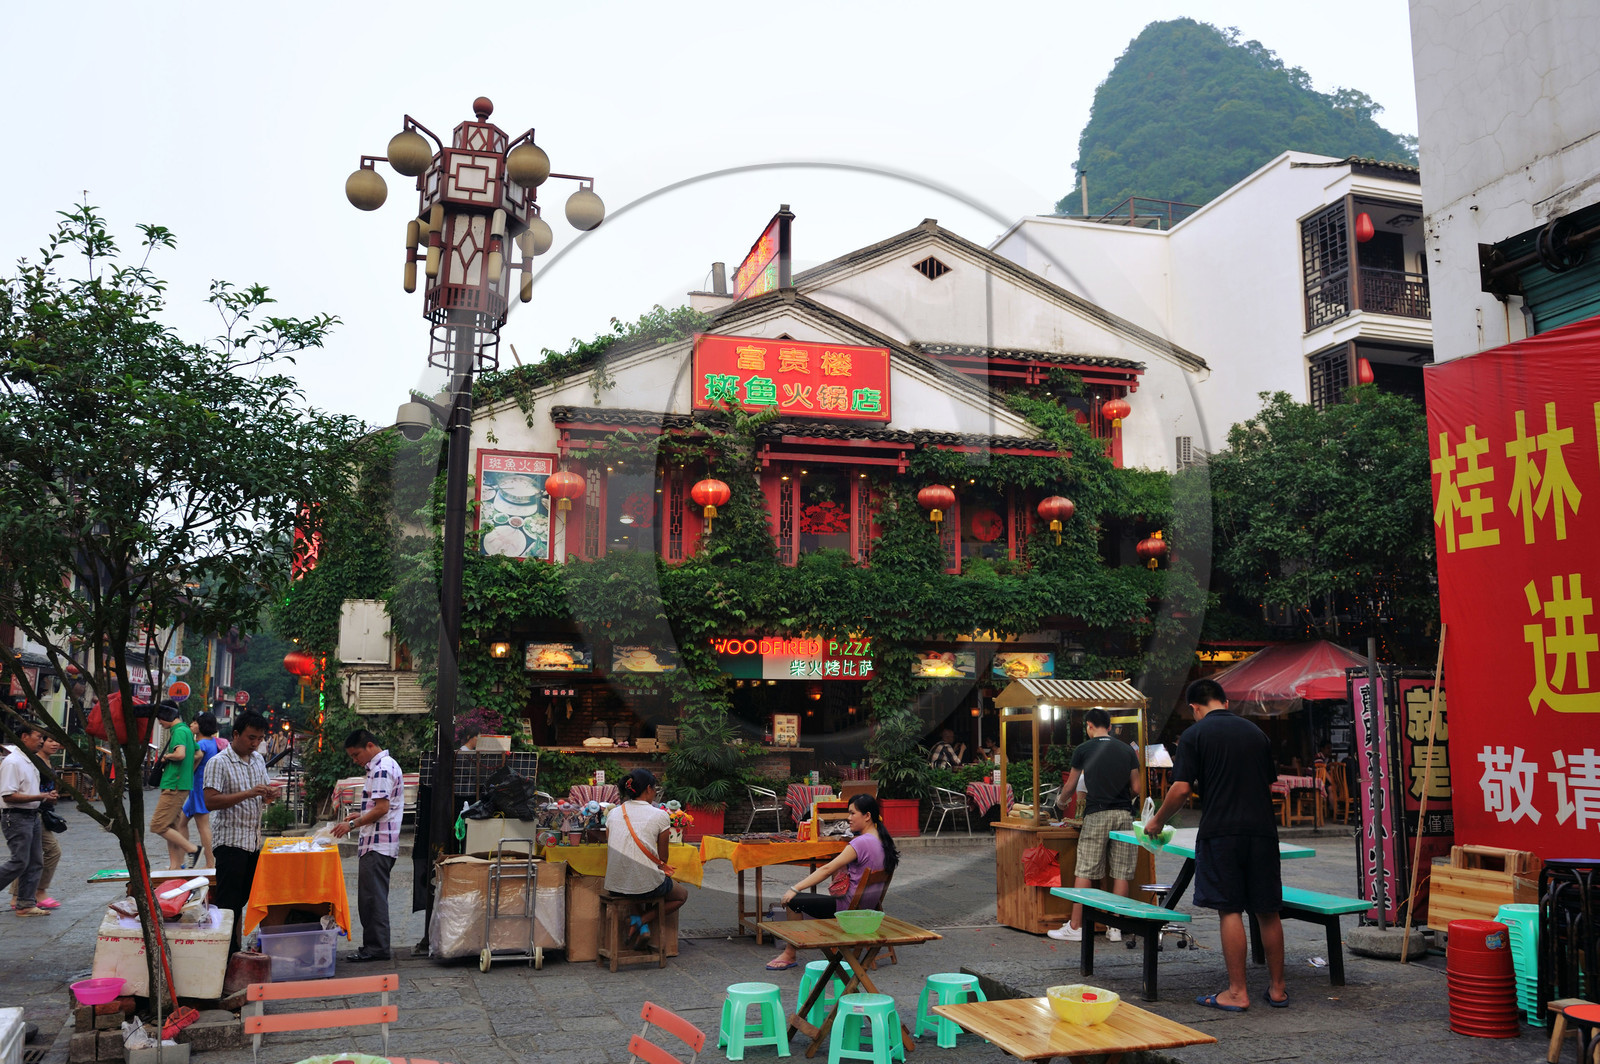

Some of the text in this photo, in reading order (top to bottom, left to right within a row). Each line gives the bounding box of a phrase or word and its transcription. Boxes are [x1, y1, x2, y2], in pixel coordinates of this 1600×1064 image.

[736, 345, 853, 377] 富贵楼
[704, 373, 882, 413] 斑鱼火锅店
[1432, 401, 1600, 554] 桂林
[710, 638, 875, 657] WOODFIRED PIZZA
[789, 659, 874, 677] 柴火烤比萨
